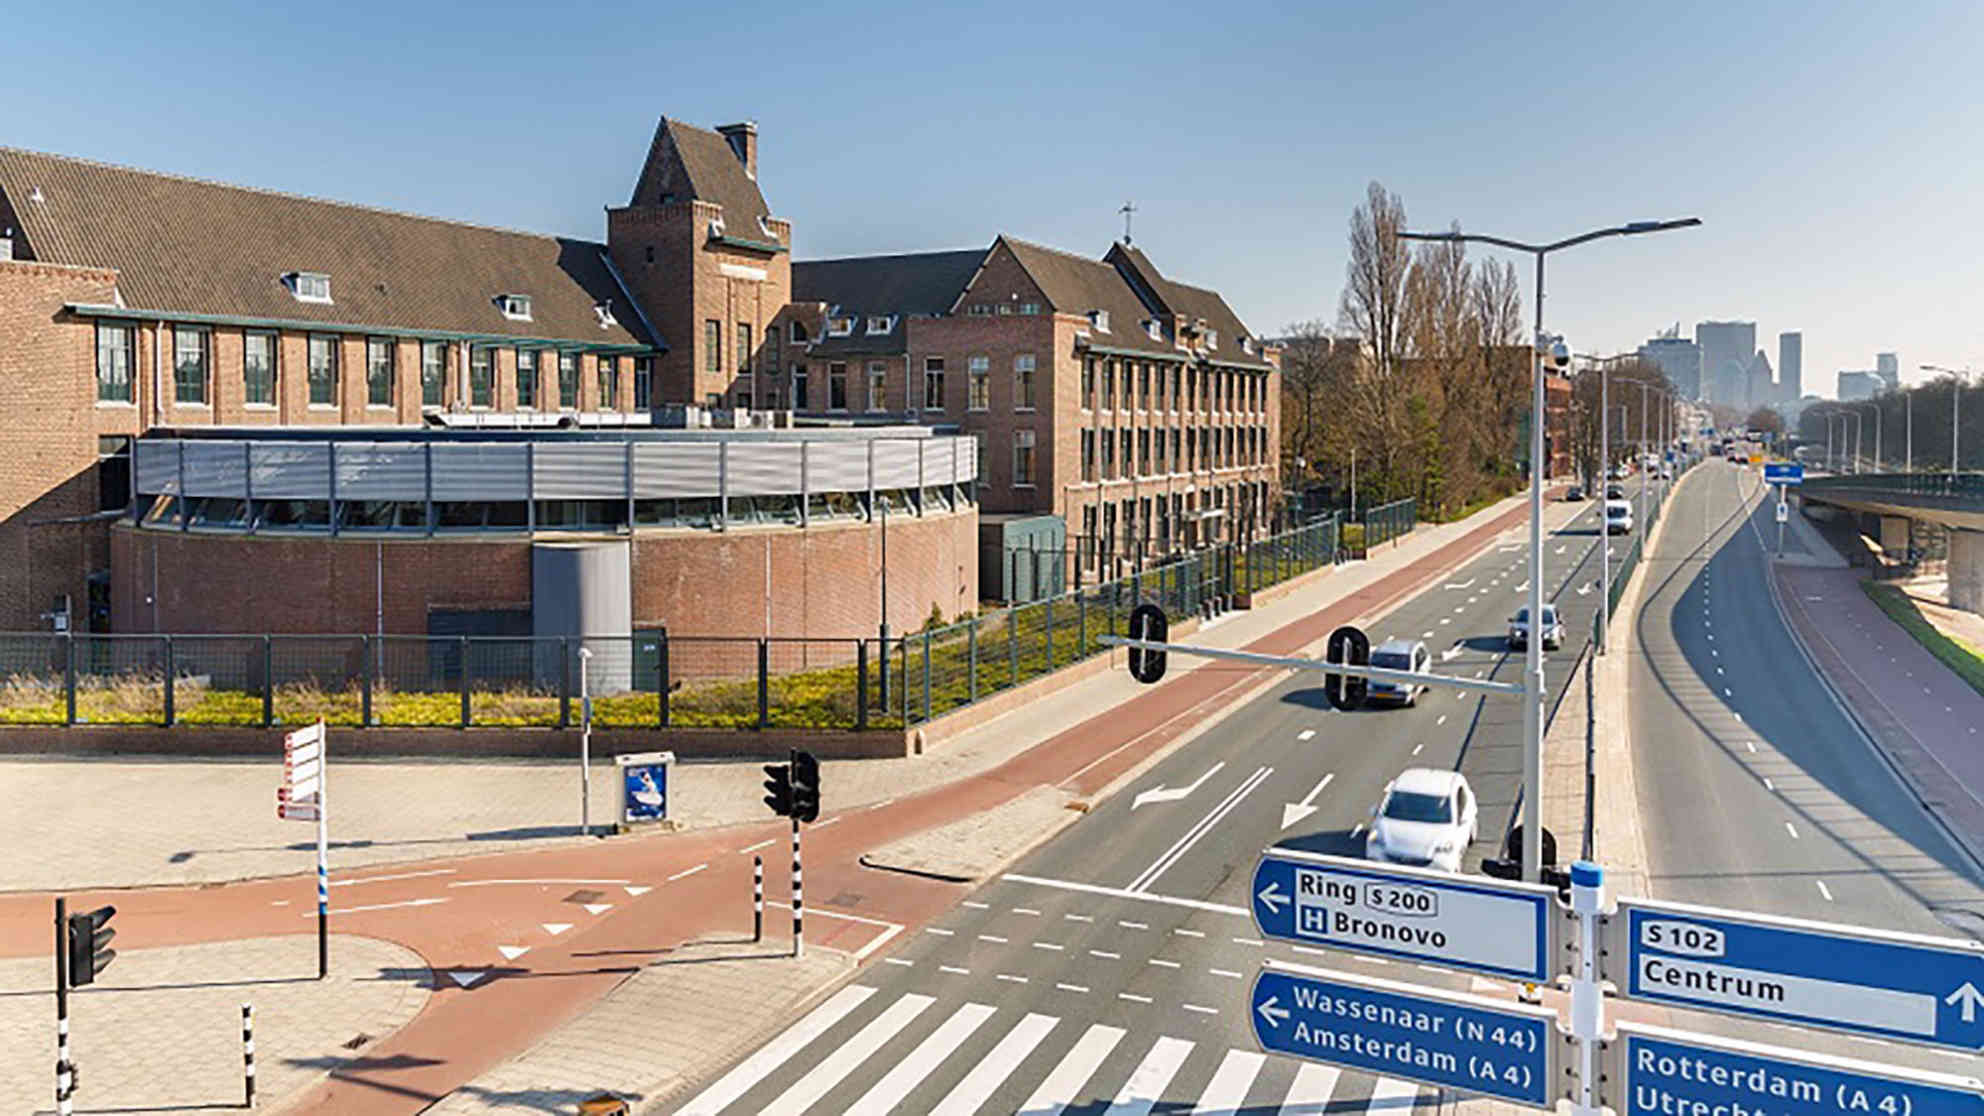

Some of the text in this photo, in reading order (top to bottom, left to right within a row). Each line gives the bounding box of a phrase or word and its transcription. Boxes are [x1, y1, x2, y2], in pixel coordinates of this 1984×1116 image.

[1300, 874, 1430, 911] Ring S 200
[1304, 911, 1446, 948] H Bronovo
[1648, 924, 1718, 951] S 102
[1645, 960, 1784, 1002] Centrum
[1293, 985, 1536, 1052] Wassenaar (N 44)
[1294, 1022, 1532, 1088] Amsterdam (A 4)
[1637, 1048, 1912, 1116] Rotterdam (A 4)
